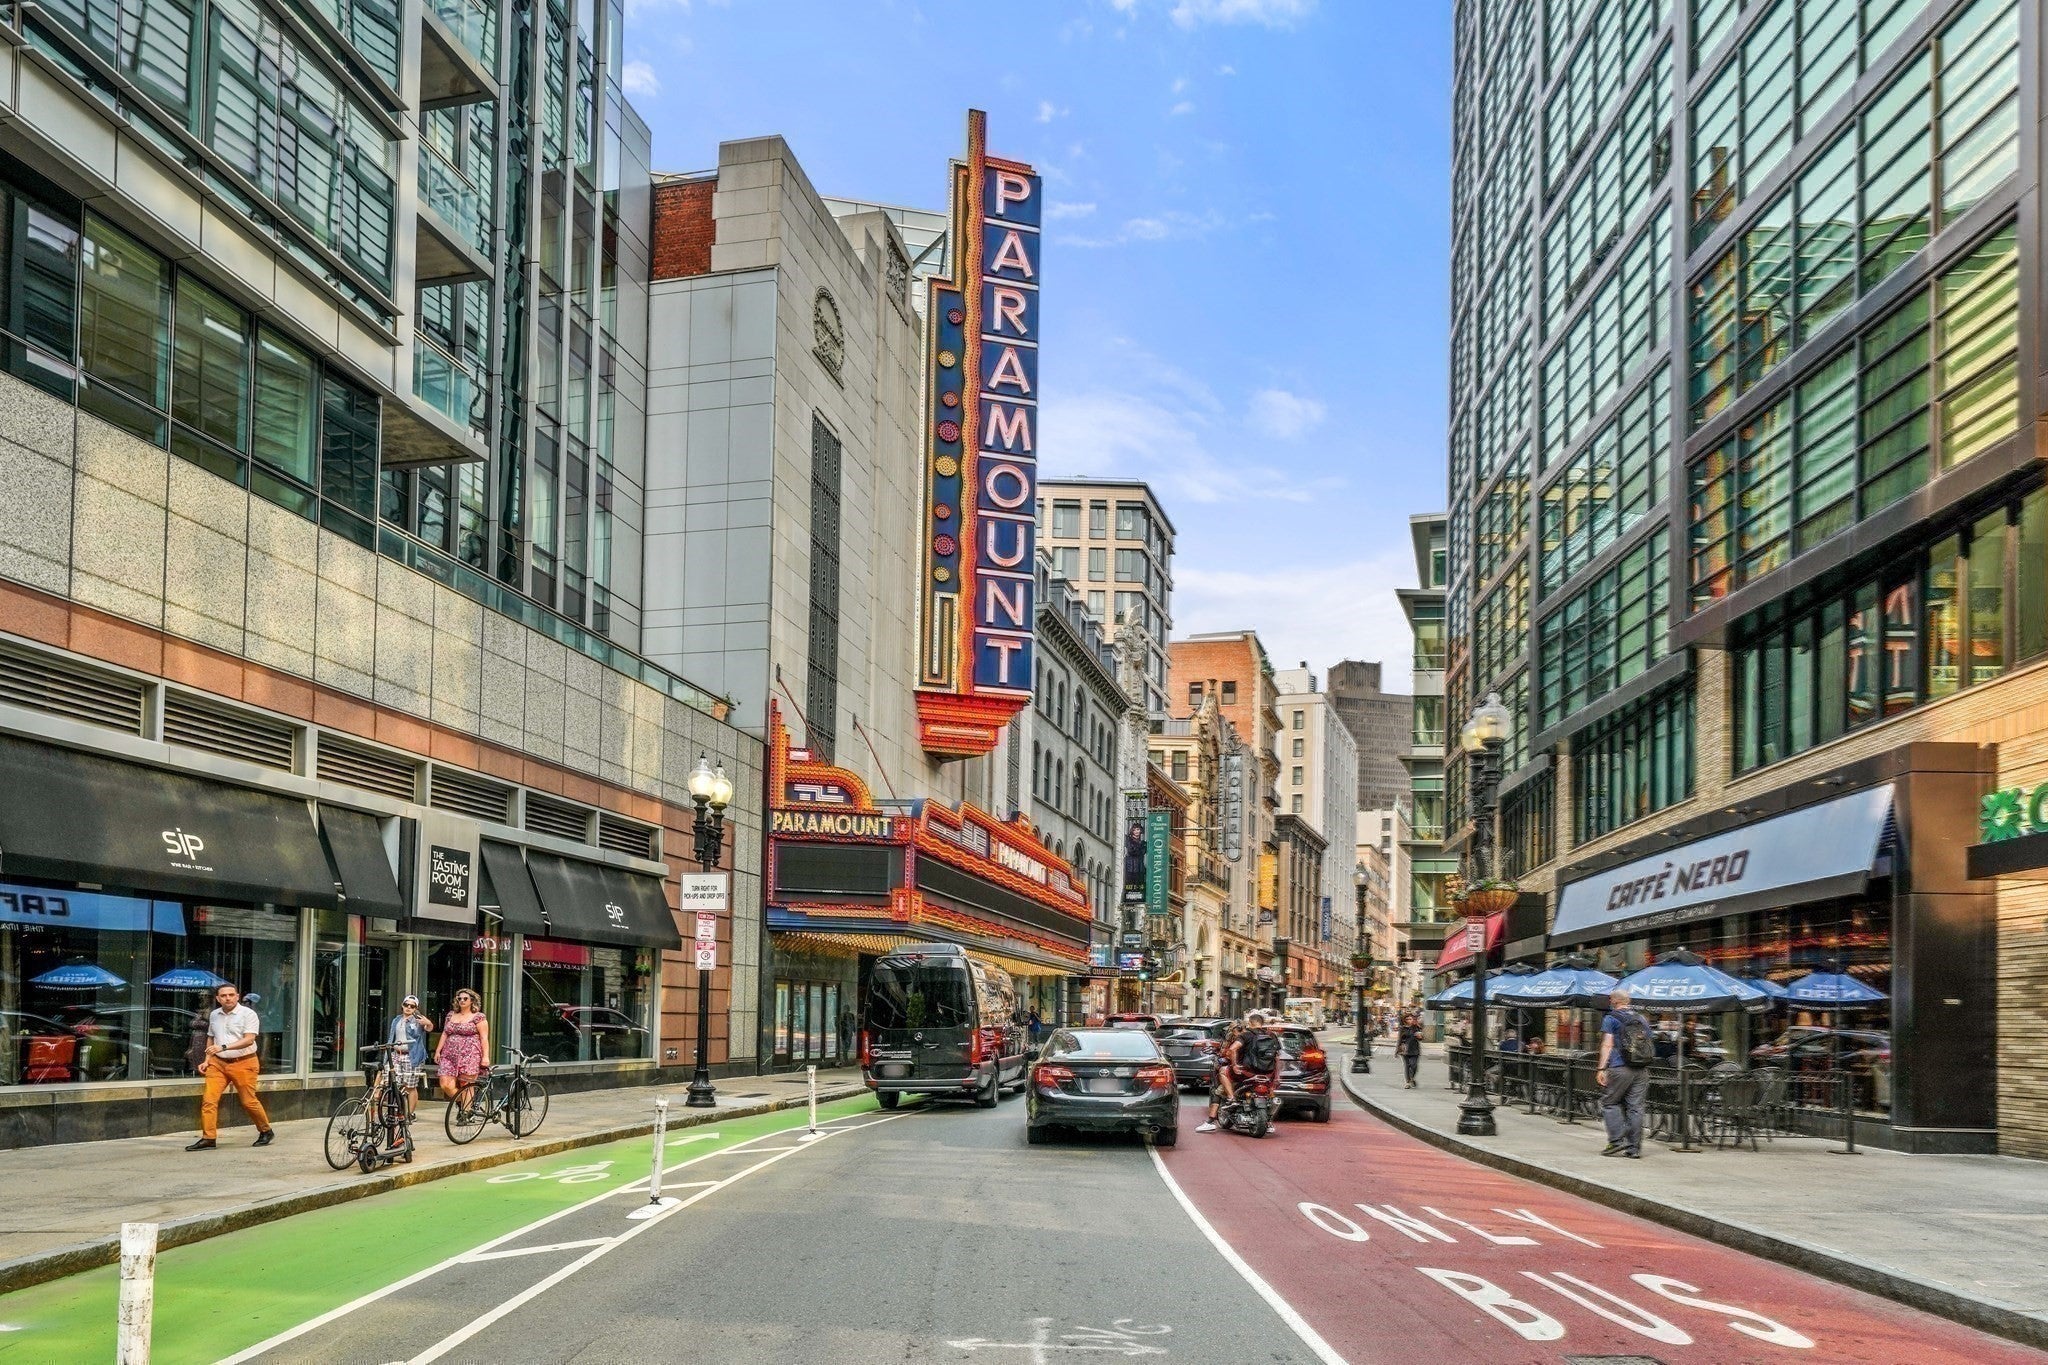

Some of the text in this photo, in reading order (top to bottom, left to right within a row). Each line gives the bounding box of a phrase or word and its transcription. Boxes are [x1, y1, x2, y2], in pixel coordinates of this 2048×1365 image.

[984, 170, 1033, 684] PARAMOUNT
[772, 811, 891, 836] PARAMOUNT
[433, 851, 445, 860] THE
[1153, 839, 1163, 874] OPERA
[432, 871, 461, 887] ROOM
[1671, 849, 1750, 896] NERO
[444, 886, 452, 894] AT
[1152, 874, 1162, 910] HOUSE
[1092, 967, 1120, 976] QUARTER
[1628, 983, 1705, 997] NERO
[1297, 1202, 1603, 1249] ONLY
[1415, 1267, 1814, 1349] BUS
